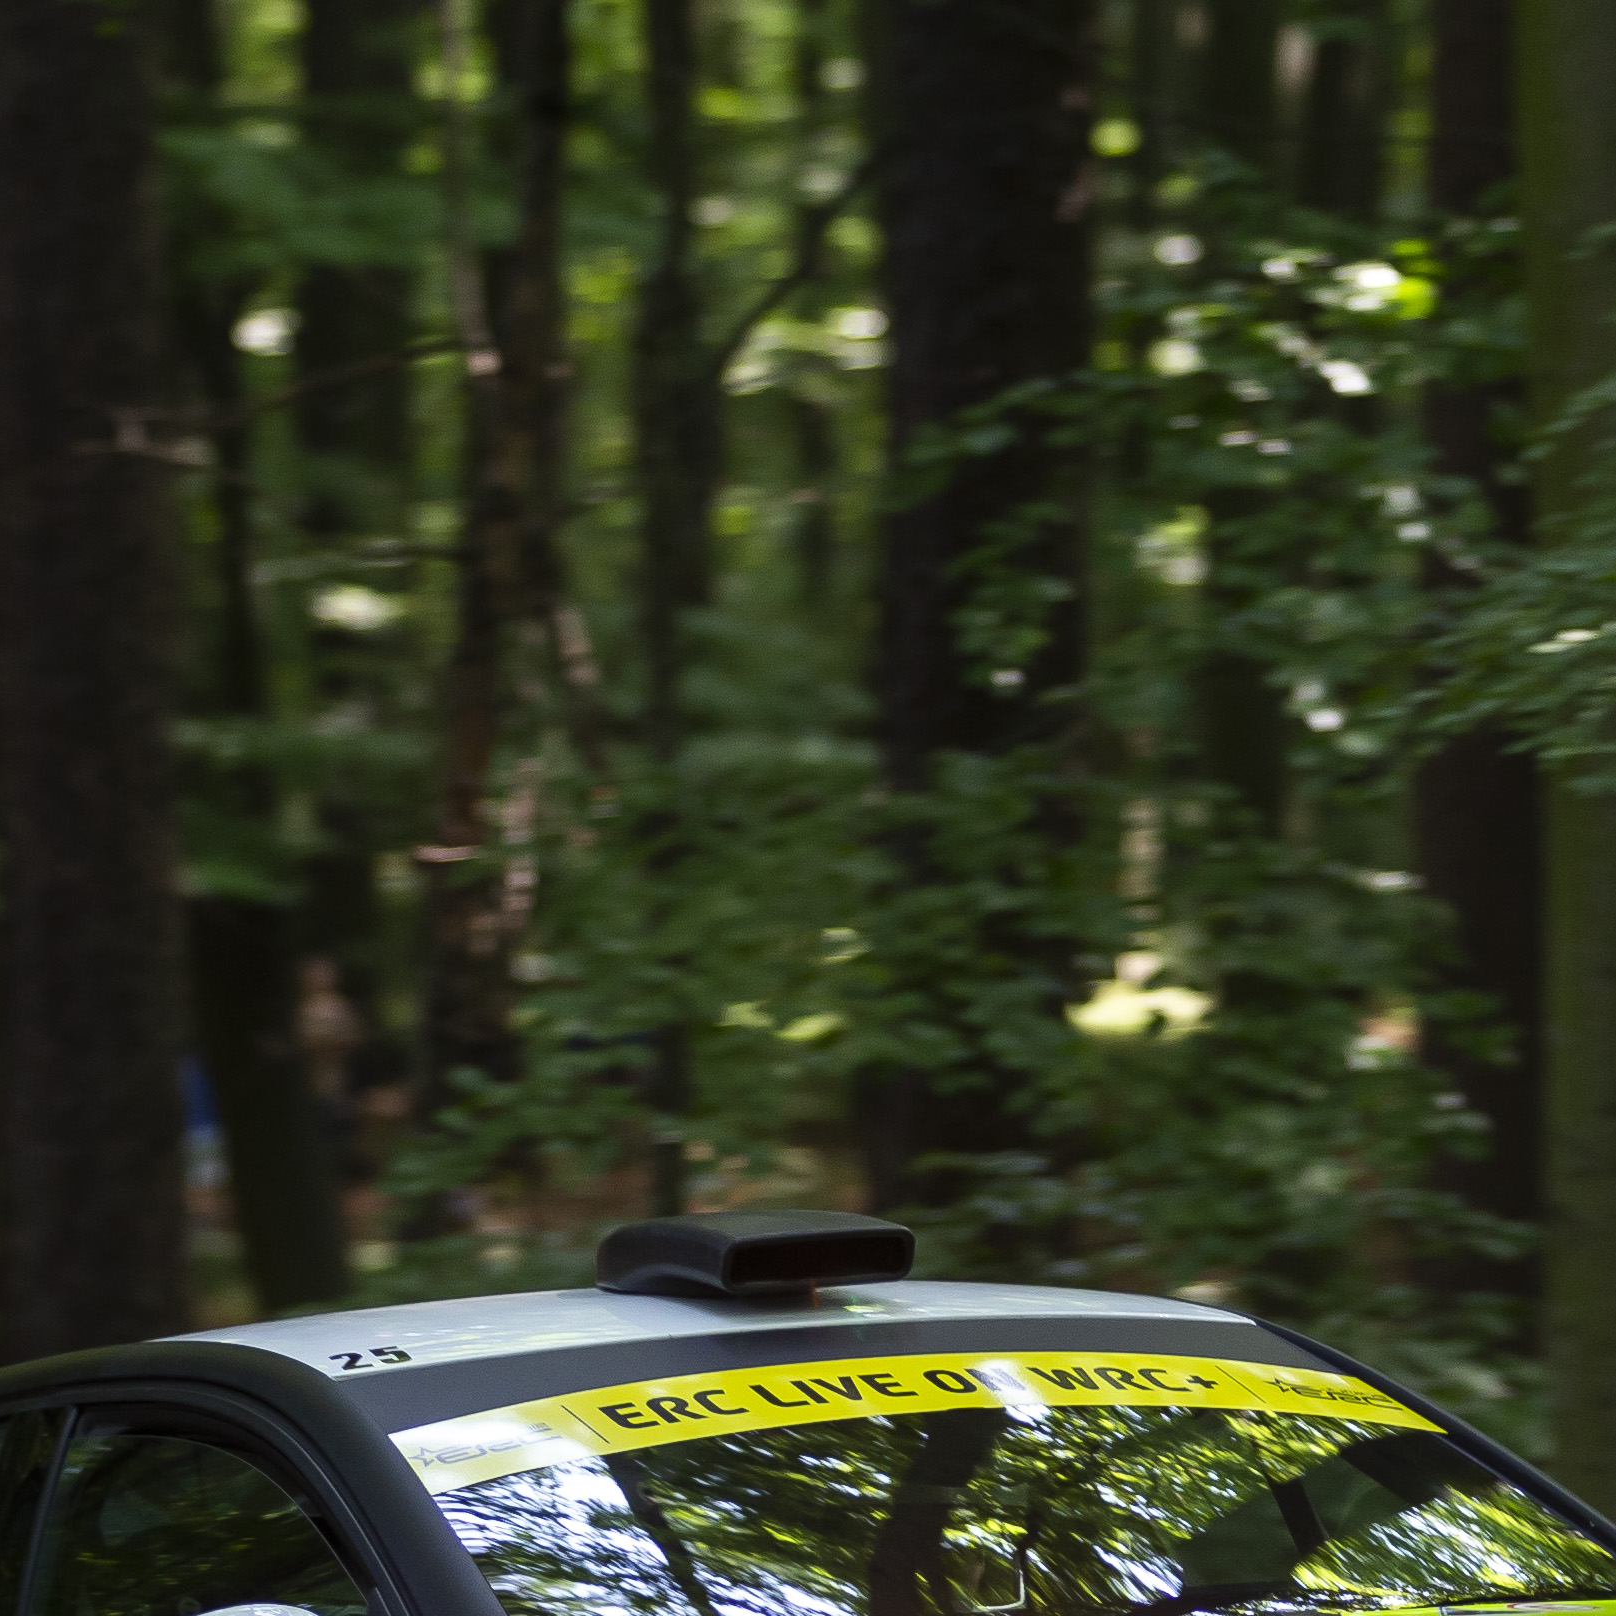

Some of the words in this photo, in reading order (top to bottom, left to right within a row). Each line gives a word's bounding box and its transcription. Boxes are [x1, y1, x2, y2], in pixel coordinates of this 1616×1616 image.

[328, 1345, 413, 1371] 25
[599, 1389, 748, 1430] ERC
[750, 1371, 915, 1409] LIVE
[922, 1367, 1026, 1395] ON
[1034, 1365, 1219, 1393] WRC+
